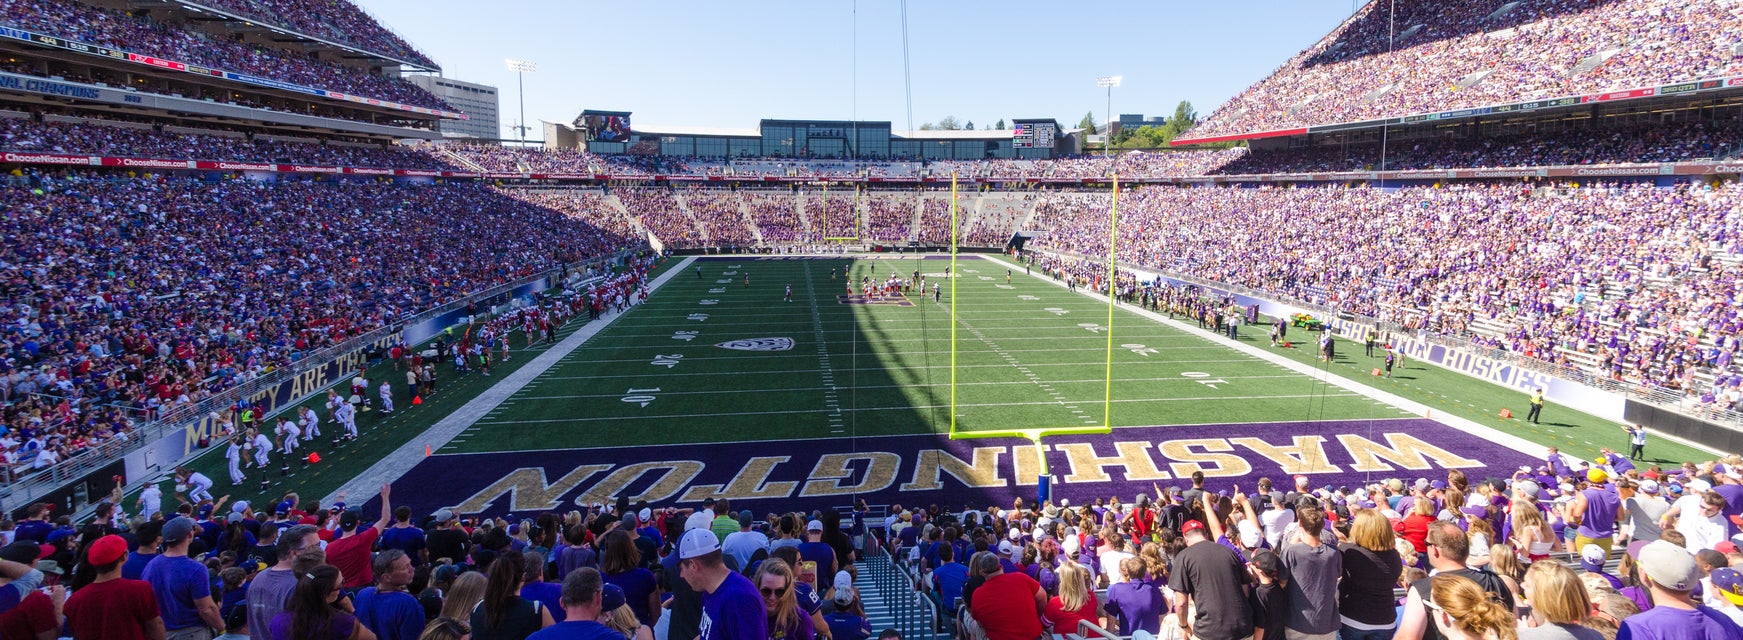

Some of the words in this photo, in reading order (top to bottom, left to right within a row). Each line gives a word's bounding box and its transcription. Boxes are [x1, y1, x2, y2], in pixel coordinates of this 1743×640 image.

[27, 80, 100, 99] CHAMPIONS
[1678, 84, 1696, 92] QTR
[5, 153, 88, 165] ChooseNissan.com
[124, 159, 187, 168] ChooseNissan.com
[220, 162, 270, 170] ChooseNissan.com
[1578, 167, 1659, 176] ChooseNissan.com
[1715, 164, 1743, 174] Choo
[1120, 343, 1160, 354] 20
[650, 353, 683, 366] 20
[1180, 371, 1229, 386] 10
[1441, 349, 1552, 396] HUSKIES
[289, 362, 328, 401] ARE
[621, 387, 661, 403] 10
[430, 432, 1488, 516] WASHINGTON
